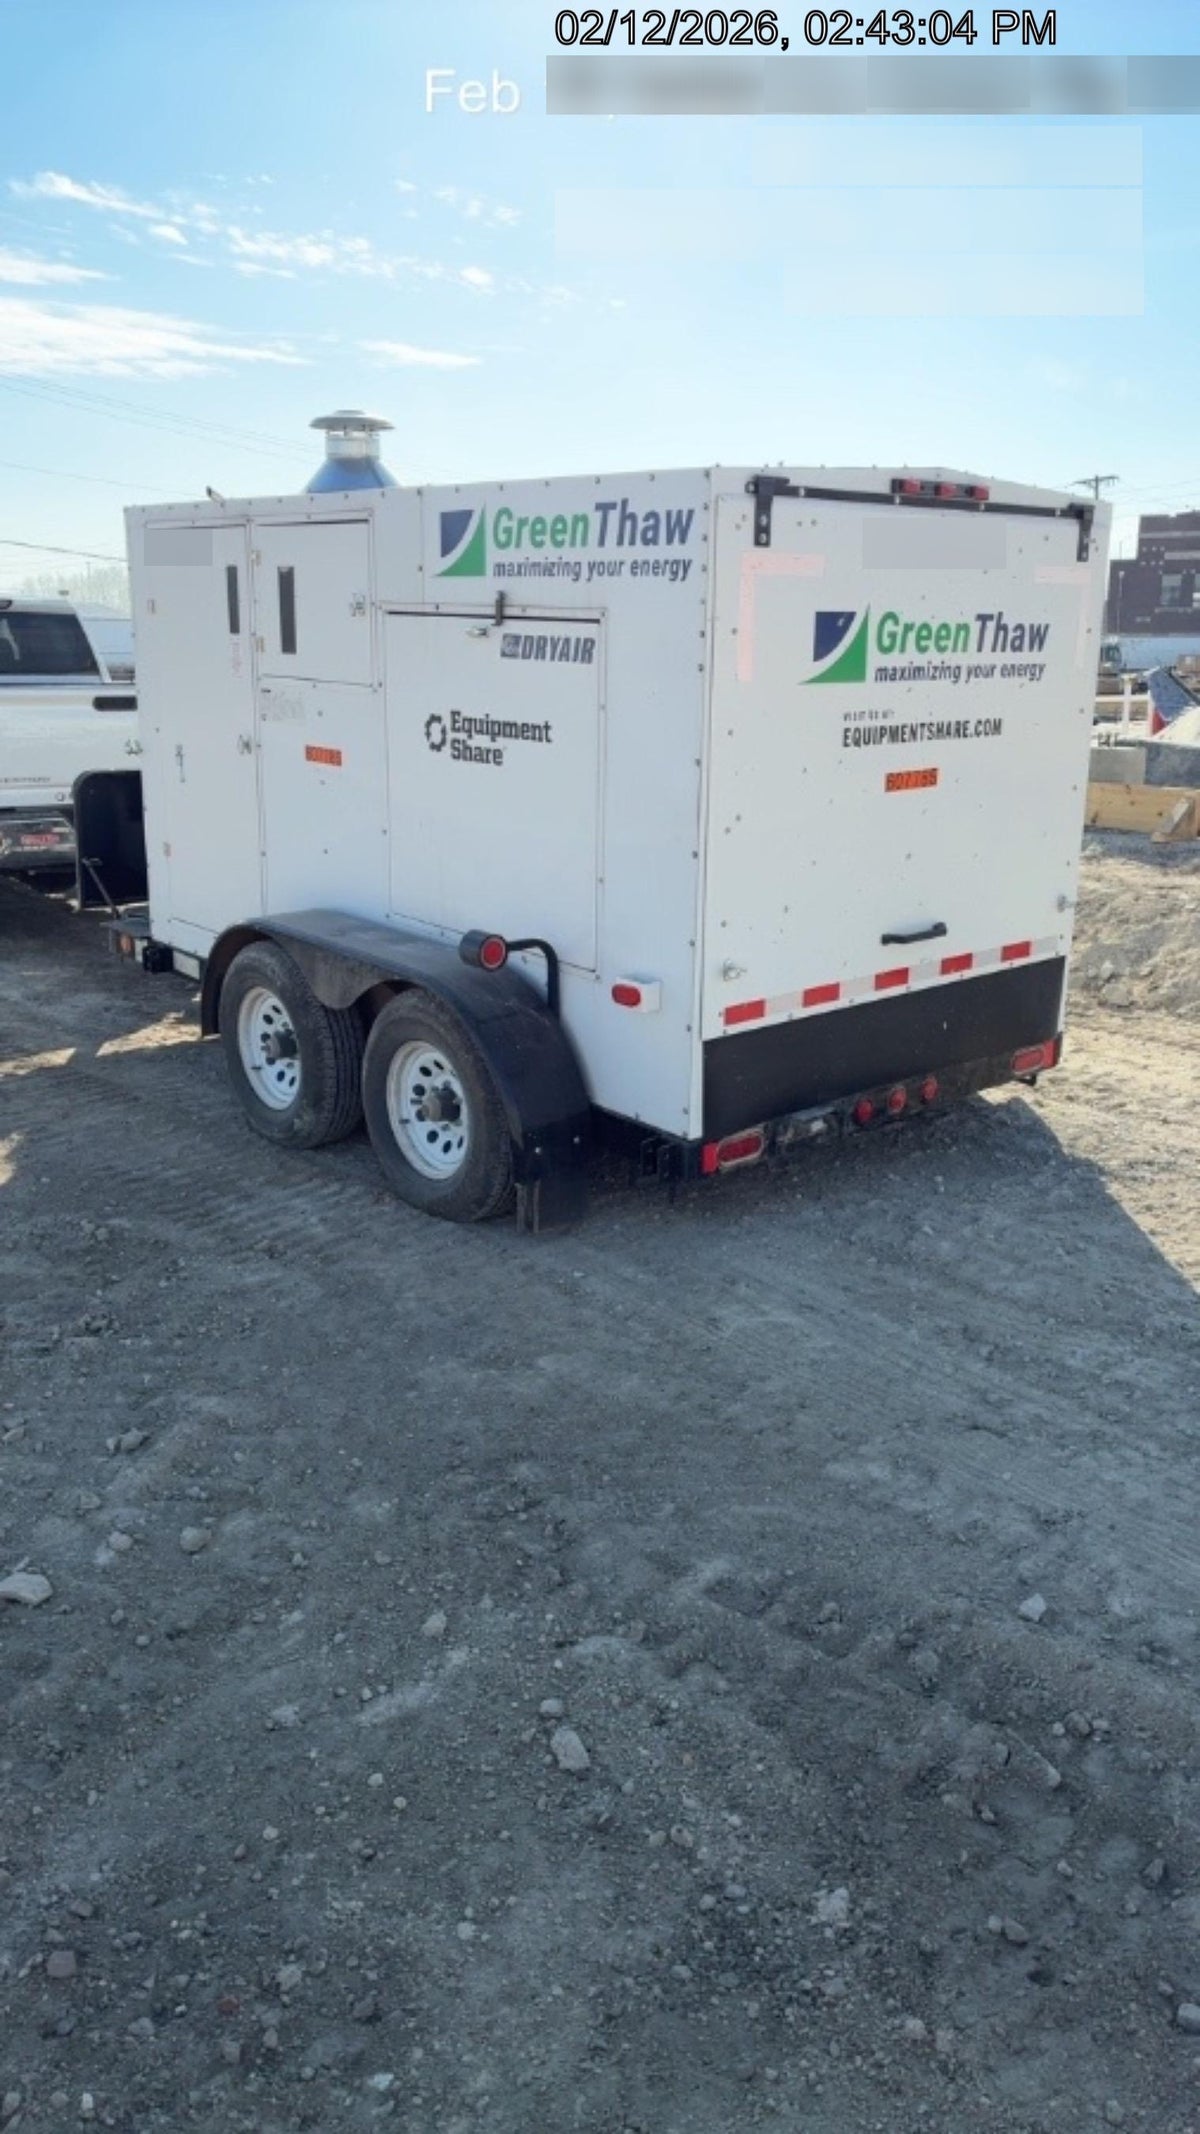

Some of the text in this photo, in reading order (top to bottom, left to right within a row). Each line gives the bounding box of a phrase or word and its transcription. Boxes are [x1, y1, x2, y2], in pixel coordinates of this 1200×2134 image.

[493, 557, 692, 582] maximizing your energy
[521, 635, 596, 664] DRYAIR
[875, 661, 1046, 684] maximizing your energy
[450, 711, 552, 743] Equipment
[843, 718, 1003, 748] EQUIPMENTSHARE.COM
[450, 740, 503, 766] Share
